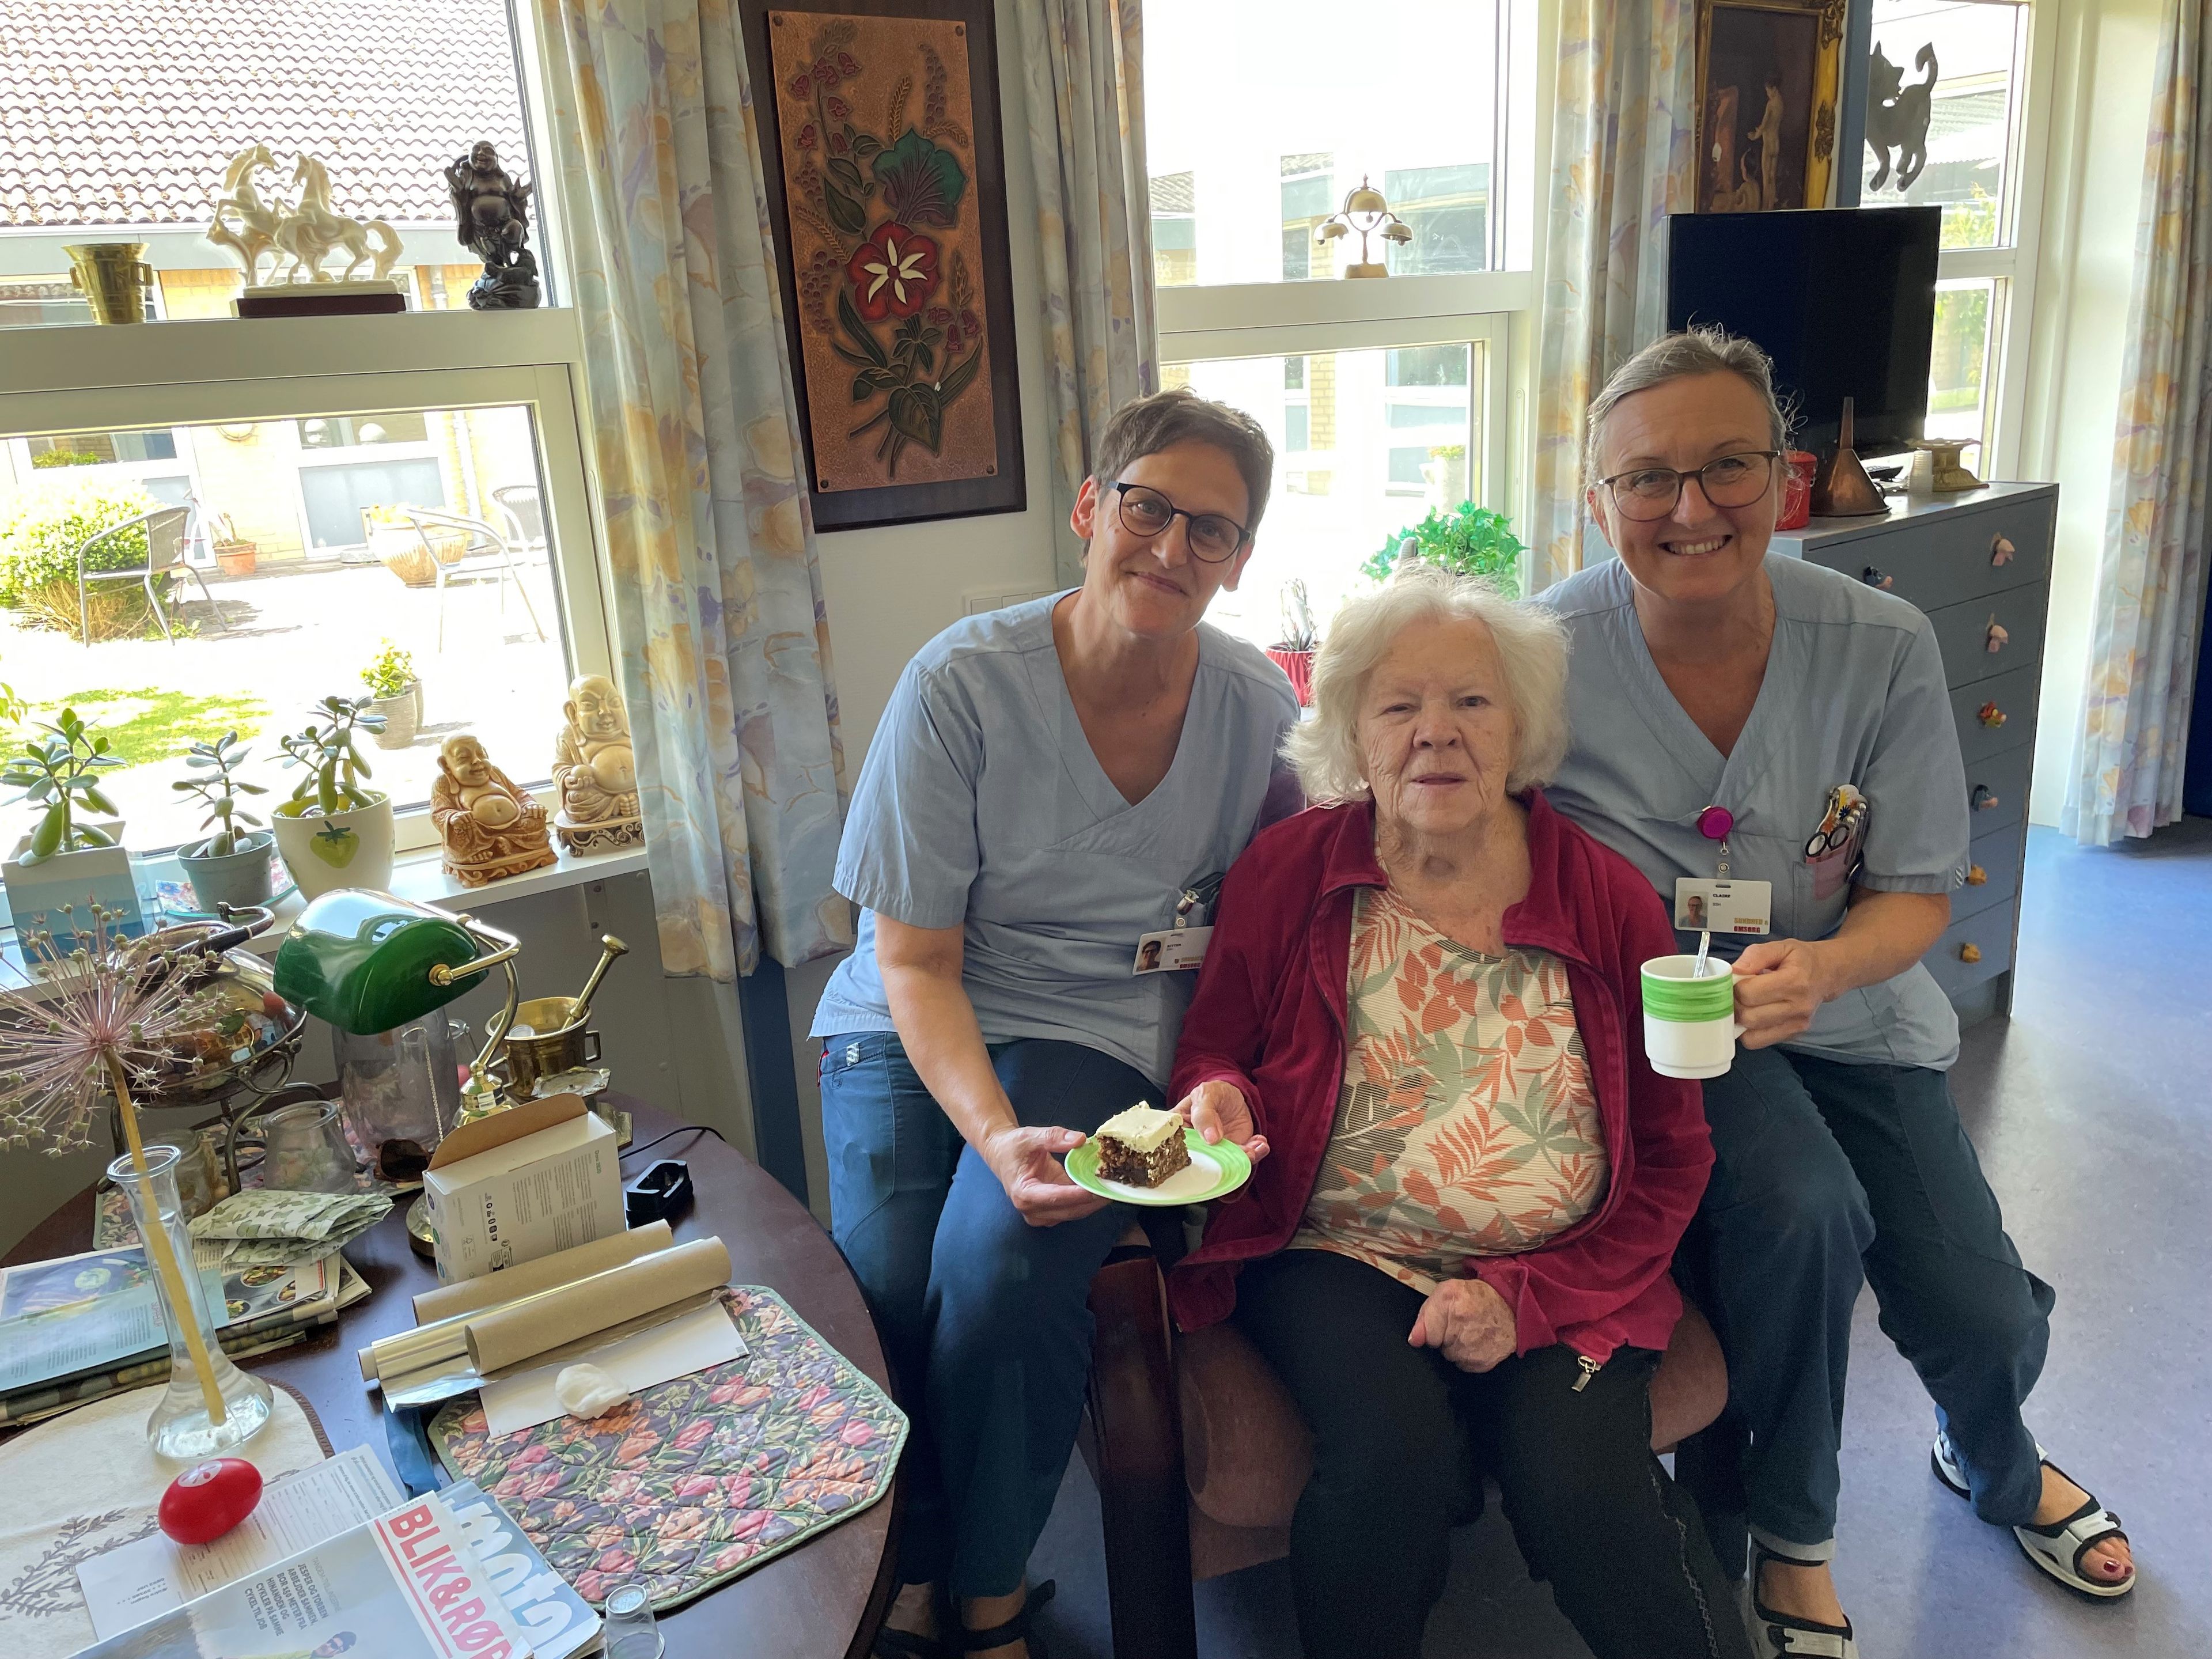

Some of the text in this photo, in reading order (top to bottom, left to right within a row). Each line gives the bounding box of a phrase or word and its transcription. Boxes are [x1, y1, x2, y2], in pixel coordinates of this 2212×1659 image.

[266, 1577, 290, 1620] HINANDEN OG
[276, 1573, 308, 1630] BOR 150 METER FRA
[287, 1568, 307, 1599] ARBEJDER
[298, 1563, 329, 1619] JESPER OG TORBEN
[245, 1588, 267, 1630] CYKEL TIL JOB
[256, 1583, 284, 1637] CYKLER PÅ SAMME
